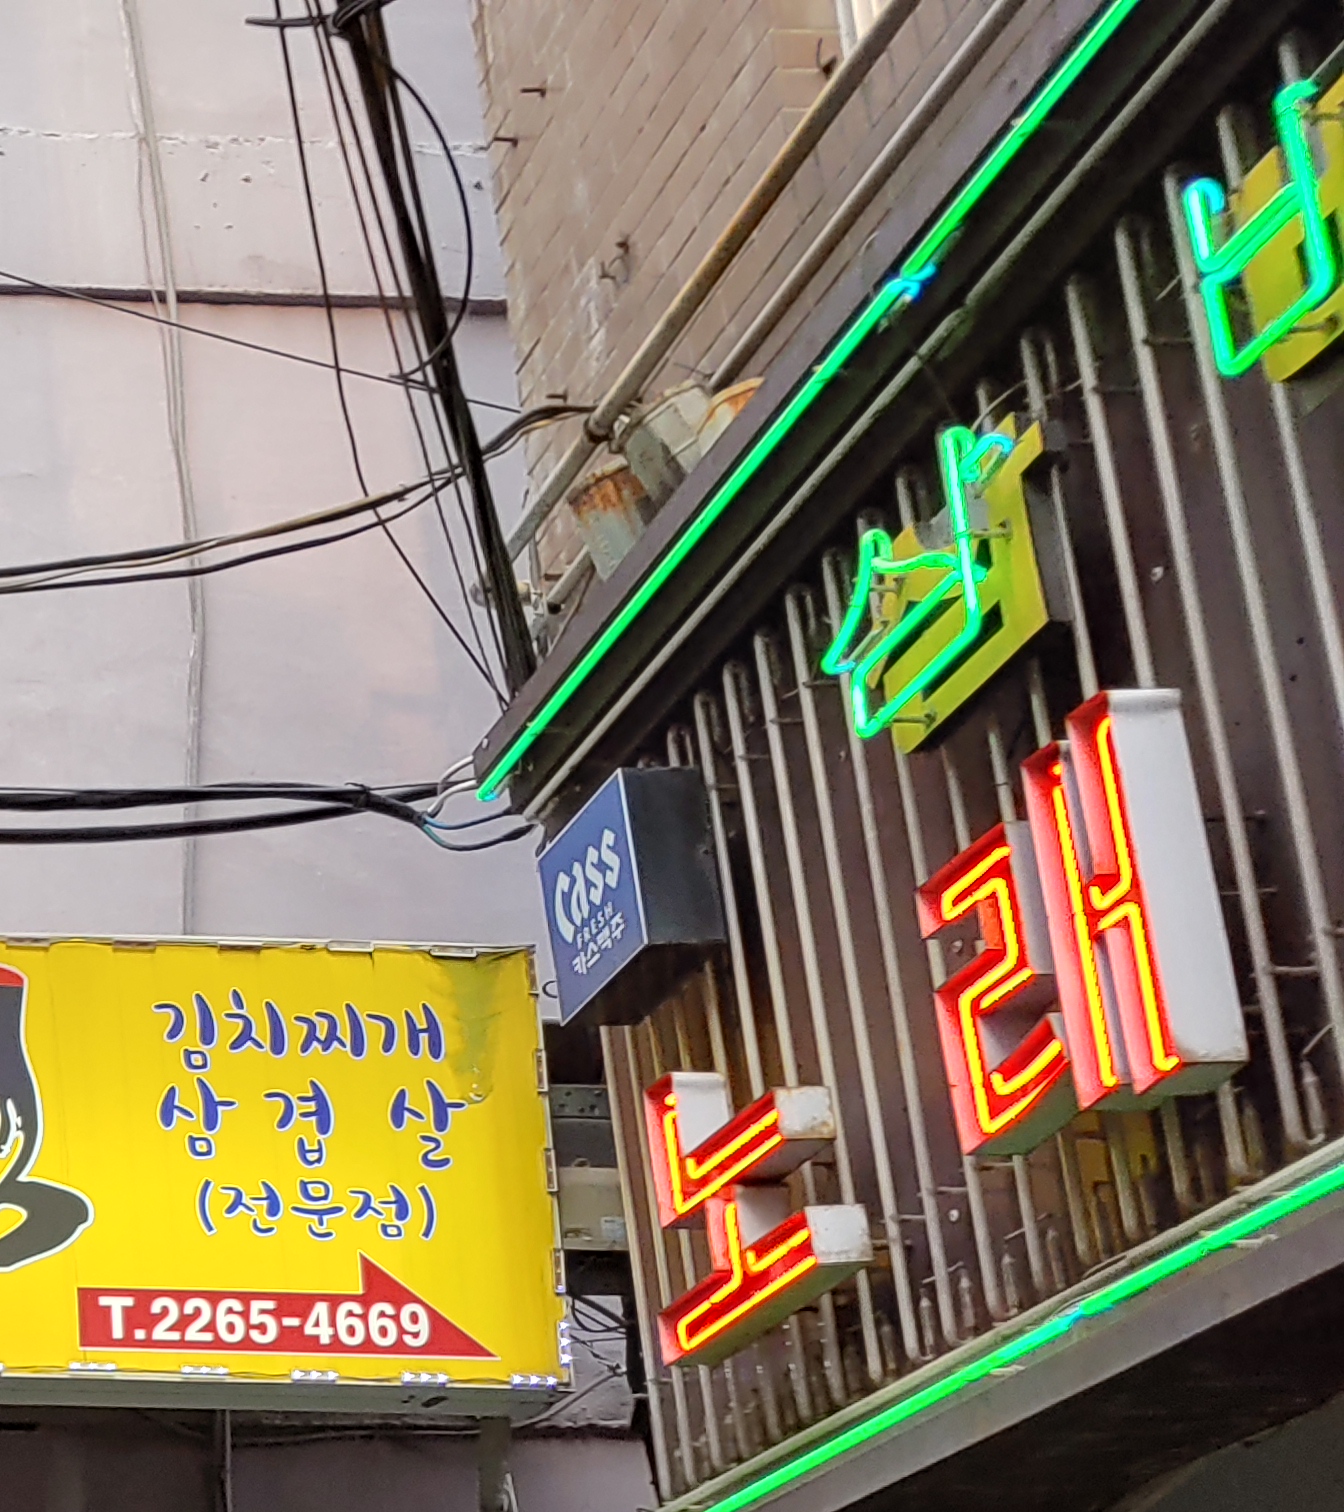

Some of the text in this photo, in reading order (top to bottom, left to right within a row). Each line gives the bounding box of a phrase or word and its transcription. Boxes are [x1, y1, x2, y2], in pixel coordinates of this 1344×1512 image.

[577, 901, 614, 950] FRESH
[153, 988, 445, 1071] 김치찌개
[197, 1176, 439, 1242] (전문점)
[98, 1295, 432, 1349] T.2265-4669
